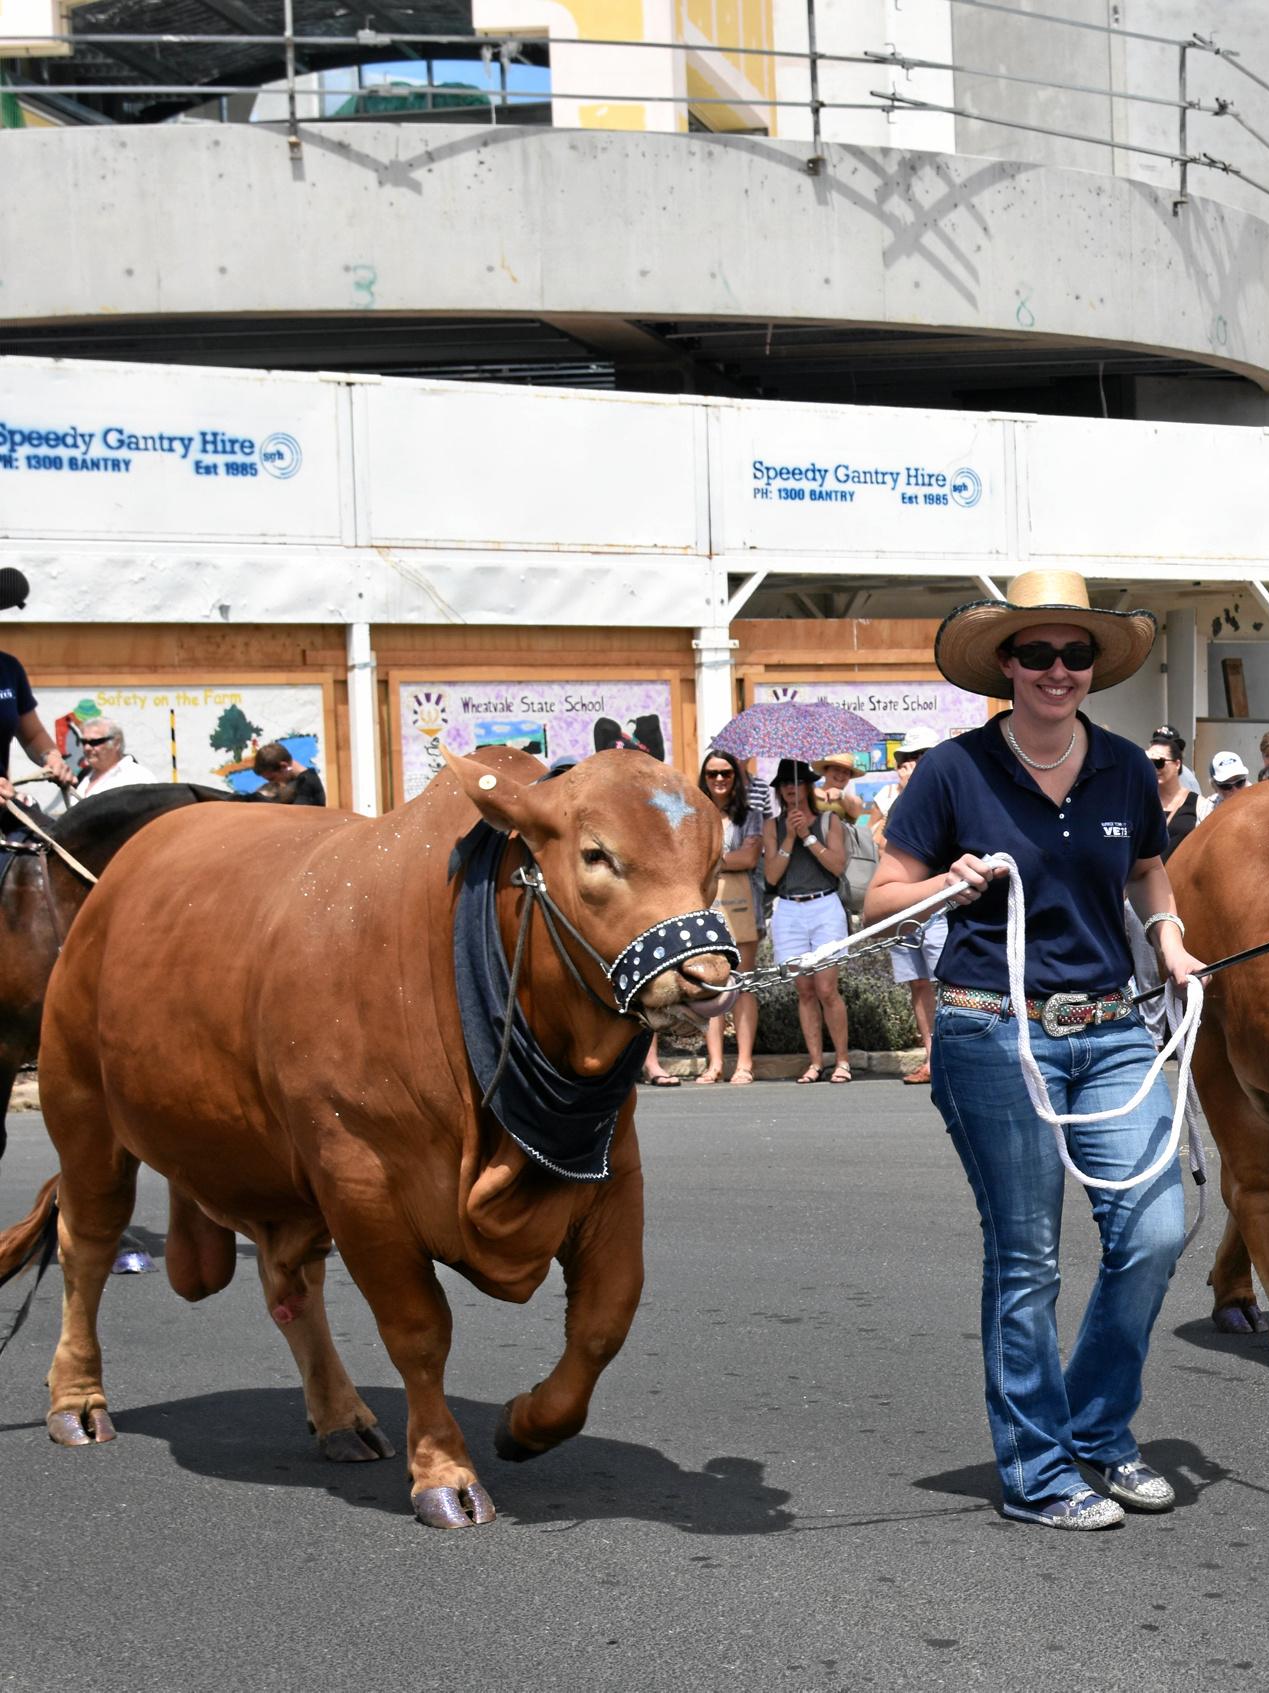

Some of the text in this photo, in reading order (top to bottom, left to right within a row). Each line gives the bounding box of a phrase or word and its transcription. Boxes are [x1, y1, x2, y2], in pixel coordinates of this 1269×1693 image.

[103, 427, 194, 459] Gantry
[200, 431, 256, 456] Hire
[26, 454, 63, 470] 1300
[69, 456, 131, 472] GANTRY
[195, 460, 258, 477] Est 1985
[752, 460, 947, 490] Speedy Gantry Hire
[753, 487, 855, 502] PH: 1300 GANTRY
[901, 492, 949, 506] Est 1985
[97, 688, 241, 709] Safety on the Farm
[461, 695, 605, 713] Wheatvale State School
[868, 695, 899, 711] State
[902, 694, 937, 711] School
